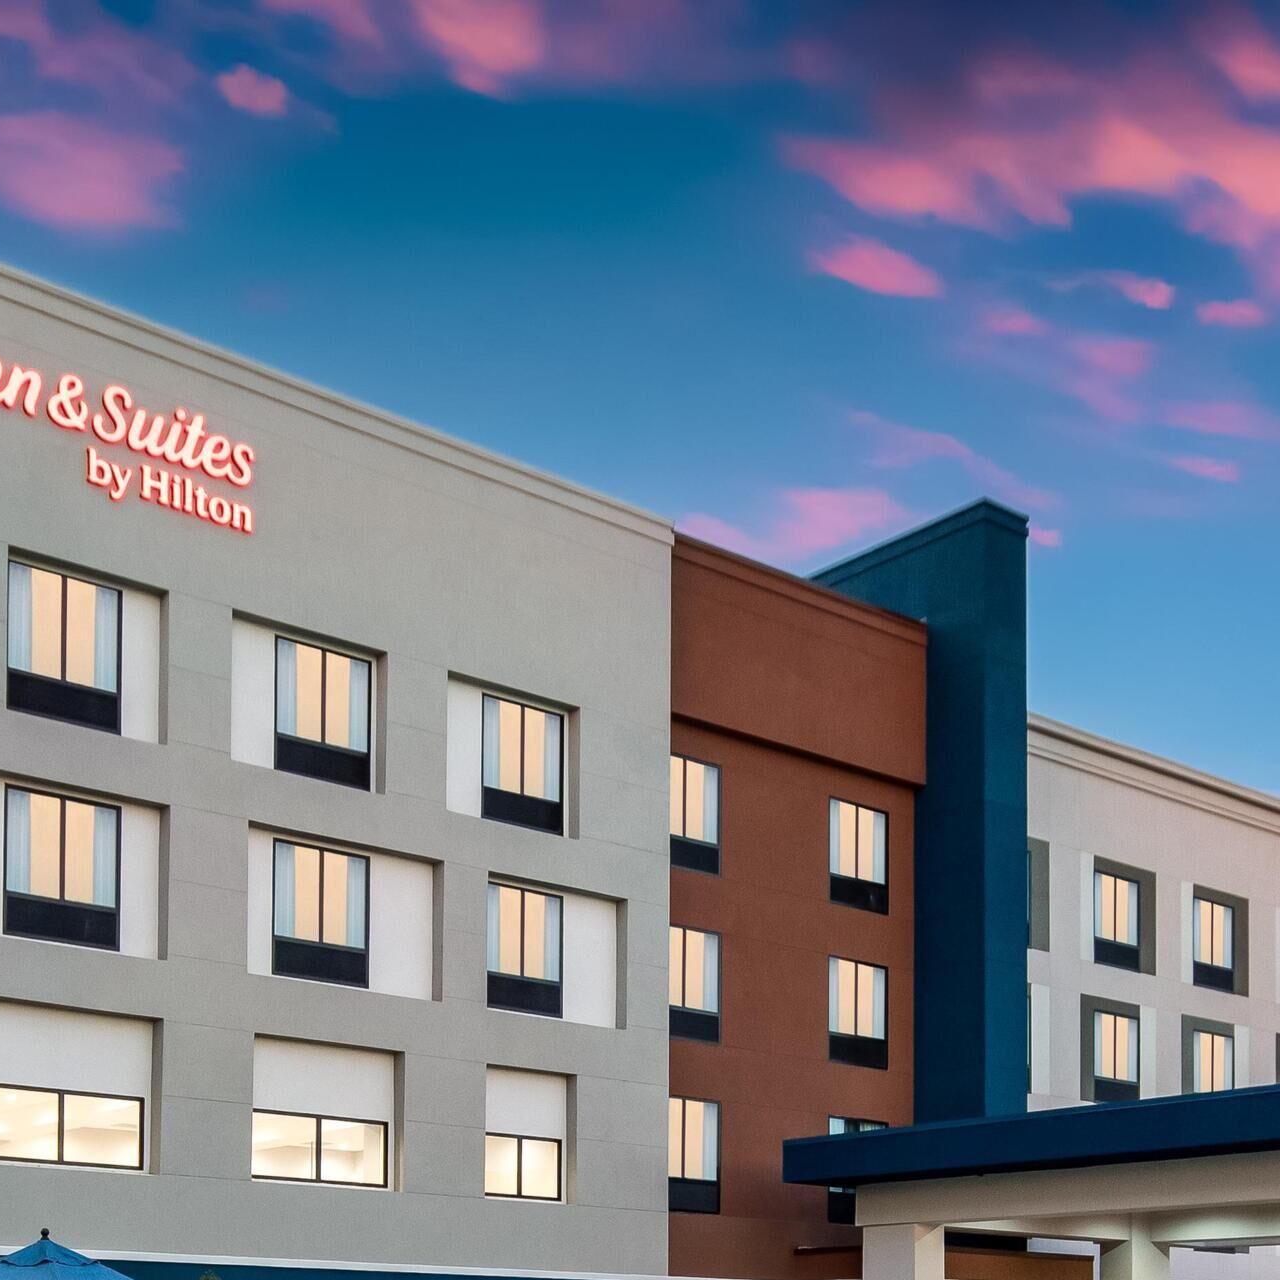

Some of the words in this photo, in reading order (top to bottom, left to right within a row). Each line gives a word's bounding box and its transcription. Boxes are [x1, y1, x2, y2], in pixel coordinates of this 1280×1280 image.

[46, 373, 89, 431] &
[91, 384, 255, 486] Suites
[86, 446, 132, 500] by
[140, 464, 253, 533] Hilton
